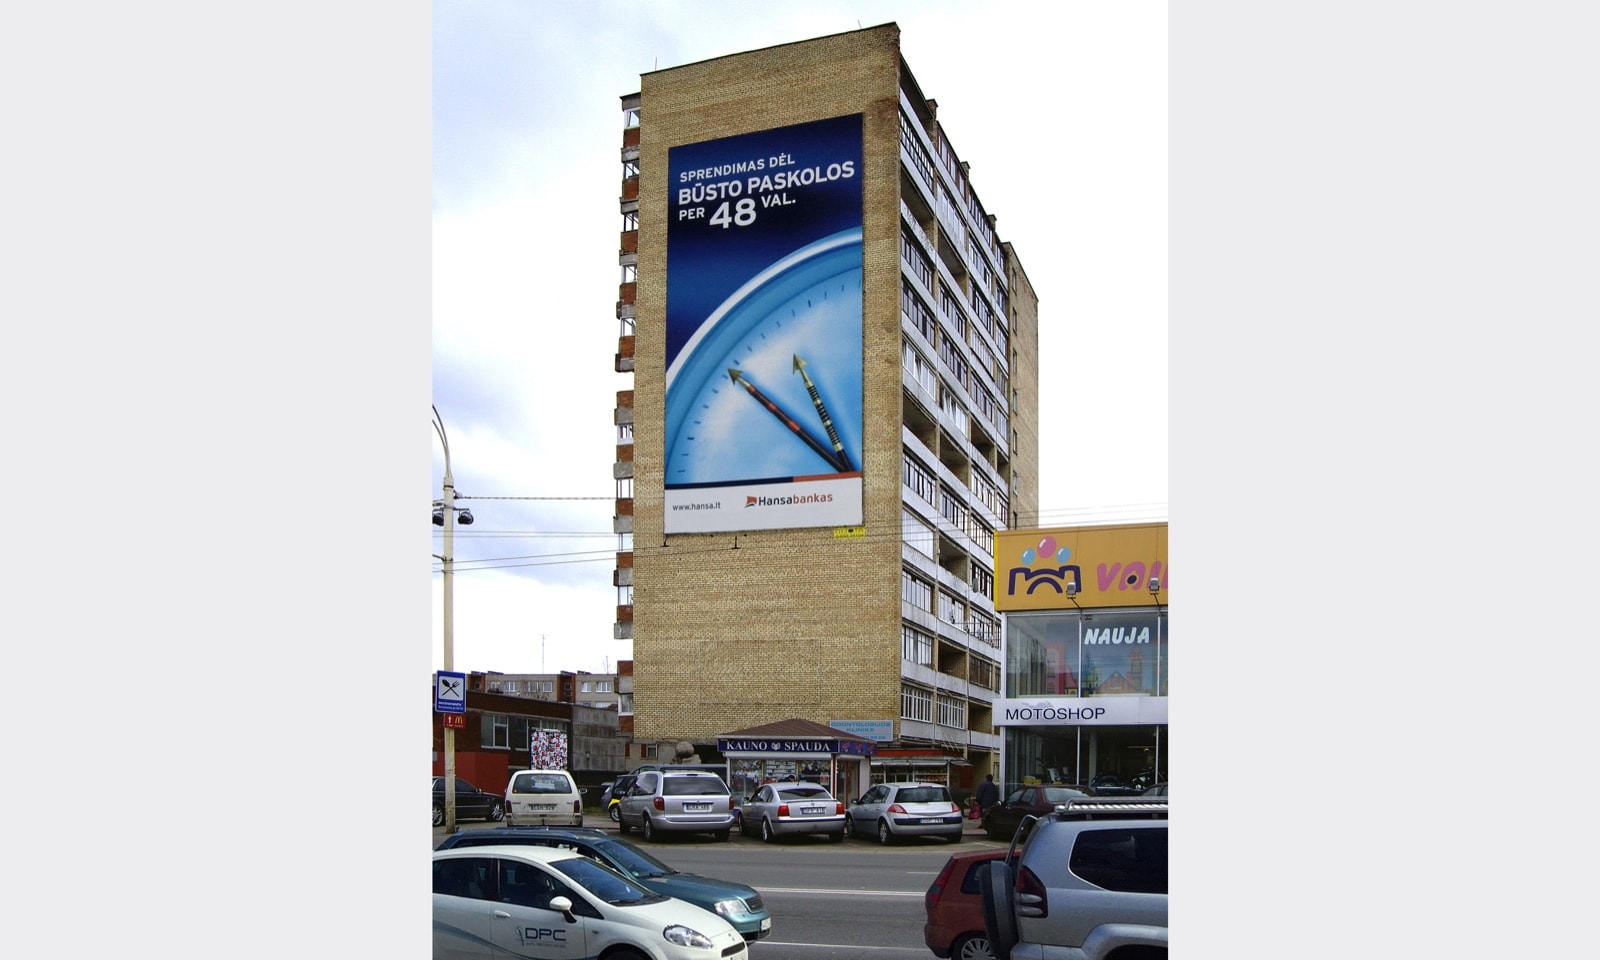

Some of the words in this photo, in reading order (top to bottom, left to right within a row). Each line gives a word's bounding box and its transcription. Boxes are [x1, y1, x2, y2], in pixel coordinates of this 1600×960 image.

[680, 159, 765, 183] SPRENDIMAS
[769, 152, 795, 168] DĖL
[679, 180, 742, 205] BŪSTO
[748, 161, 855, 194] PASKOLOS
[679, 207, 705, 220] PER
[709, 198, 757, 229] 48
[761, 192, 796, 208] VAL.
[672, 501, 721, 511] www.hansa.lt
[758, 493, 833, 506] Hansabankas
[1084, 627, 1150, 645] NAUJA
[1005, 708, 1106, 720] MOTOSHOP
[726, 741, 768, 751] KAUNO
[784, 741, 830, 752] SPAUDA
[525, 927, 566, 941] DPC
